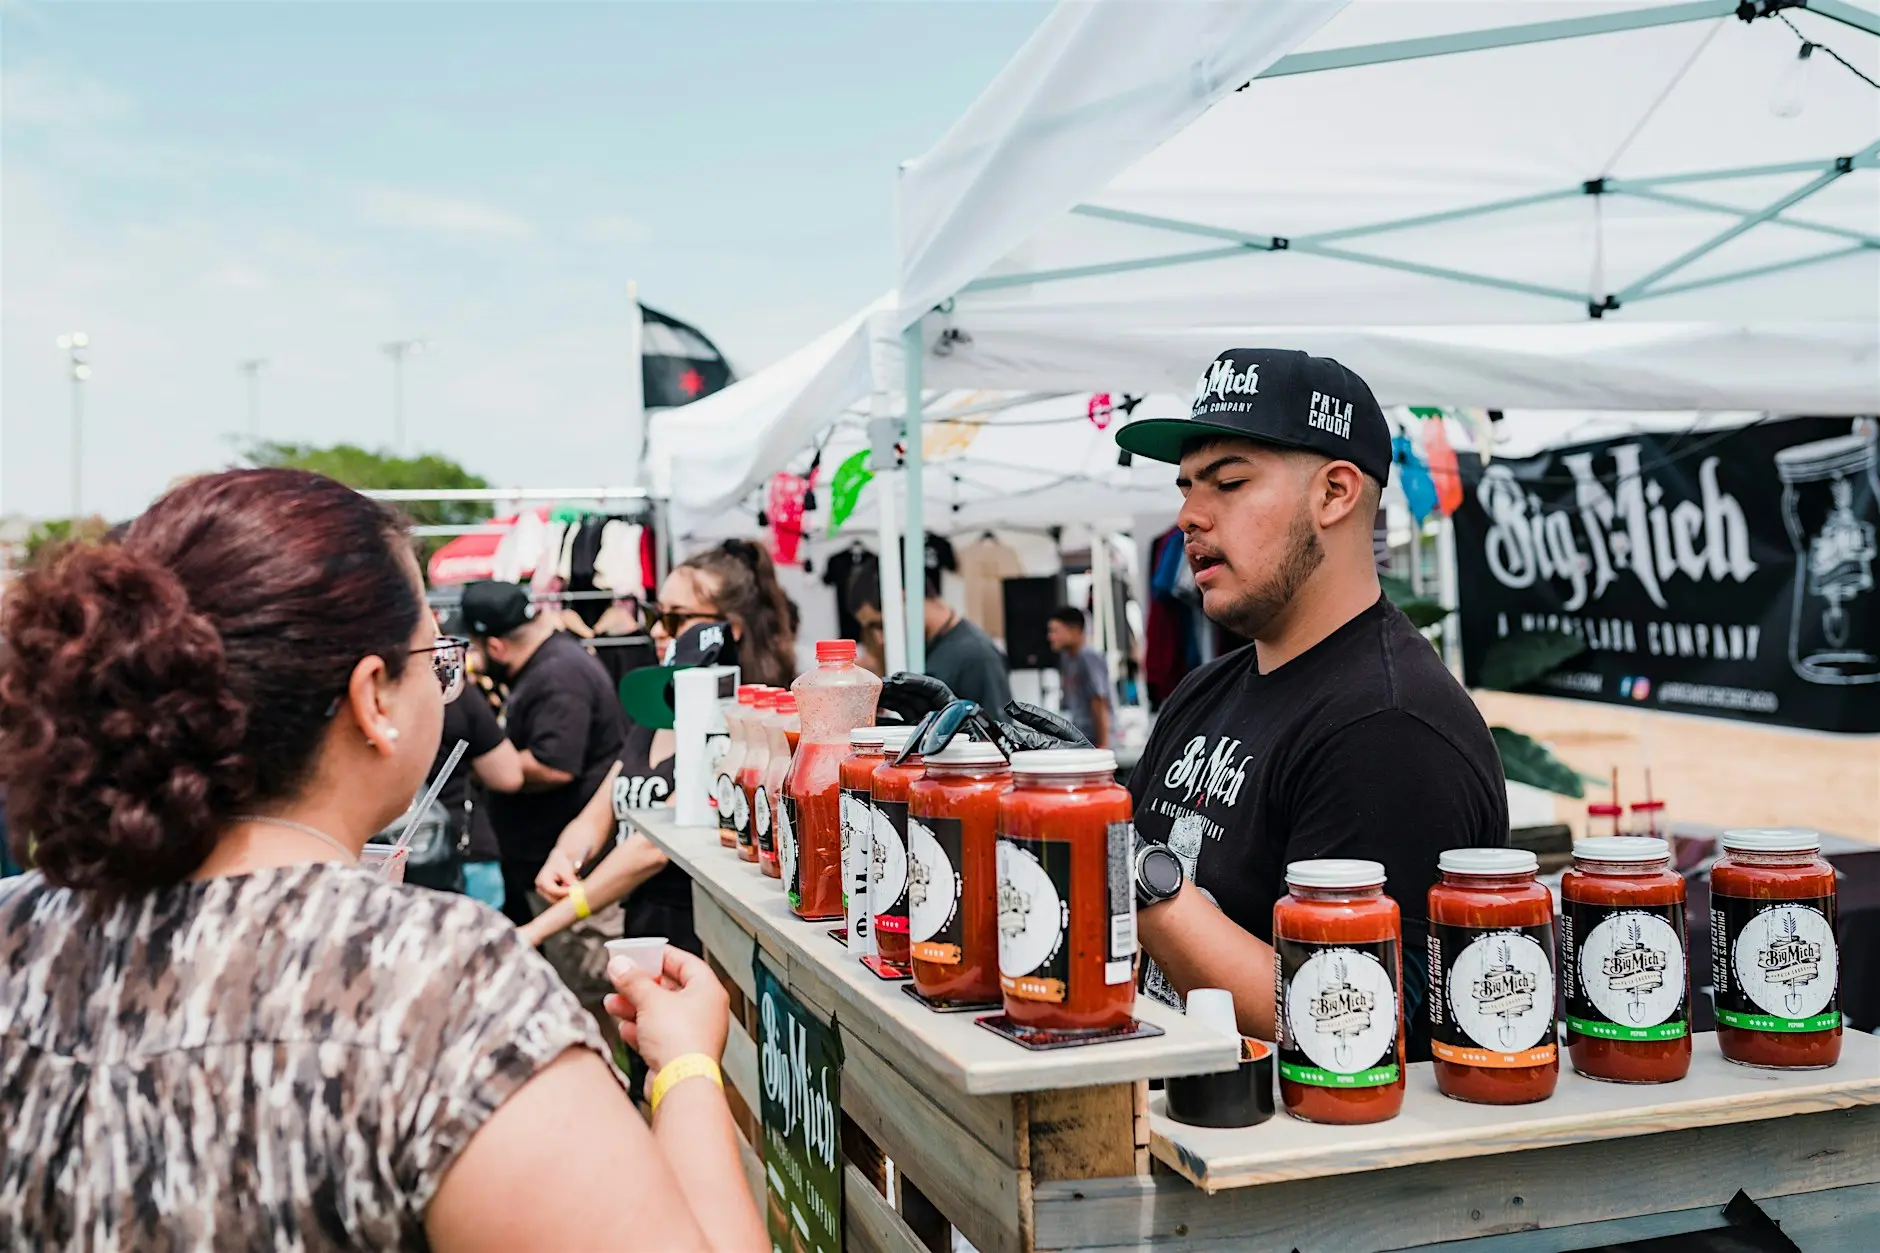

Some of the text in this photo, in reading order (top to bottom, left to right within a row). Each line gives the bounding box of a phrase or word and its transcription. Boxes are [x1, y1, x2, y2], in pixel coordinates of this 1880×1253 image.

[1203, 359, 1260, 401] Mich
[1210, 402, 1252, 413] COMPANY
[1308, 409, 1350, 440] CRUDA
[1647, 621, 1761, 661] COMPANY
[1717, 910, 1727, 956] CHICAGO'S
